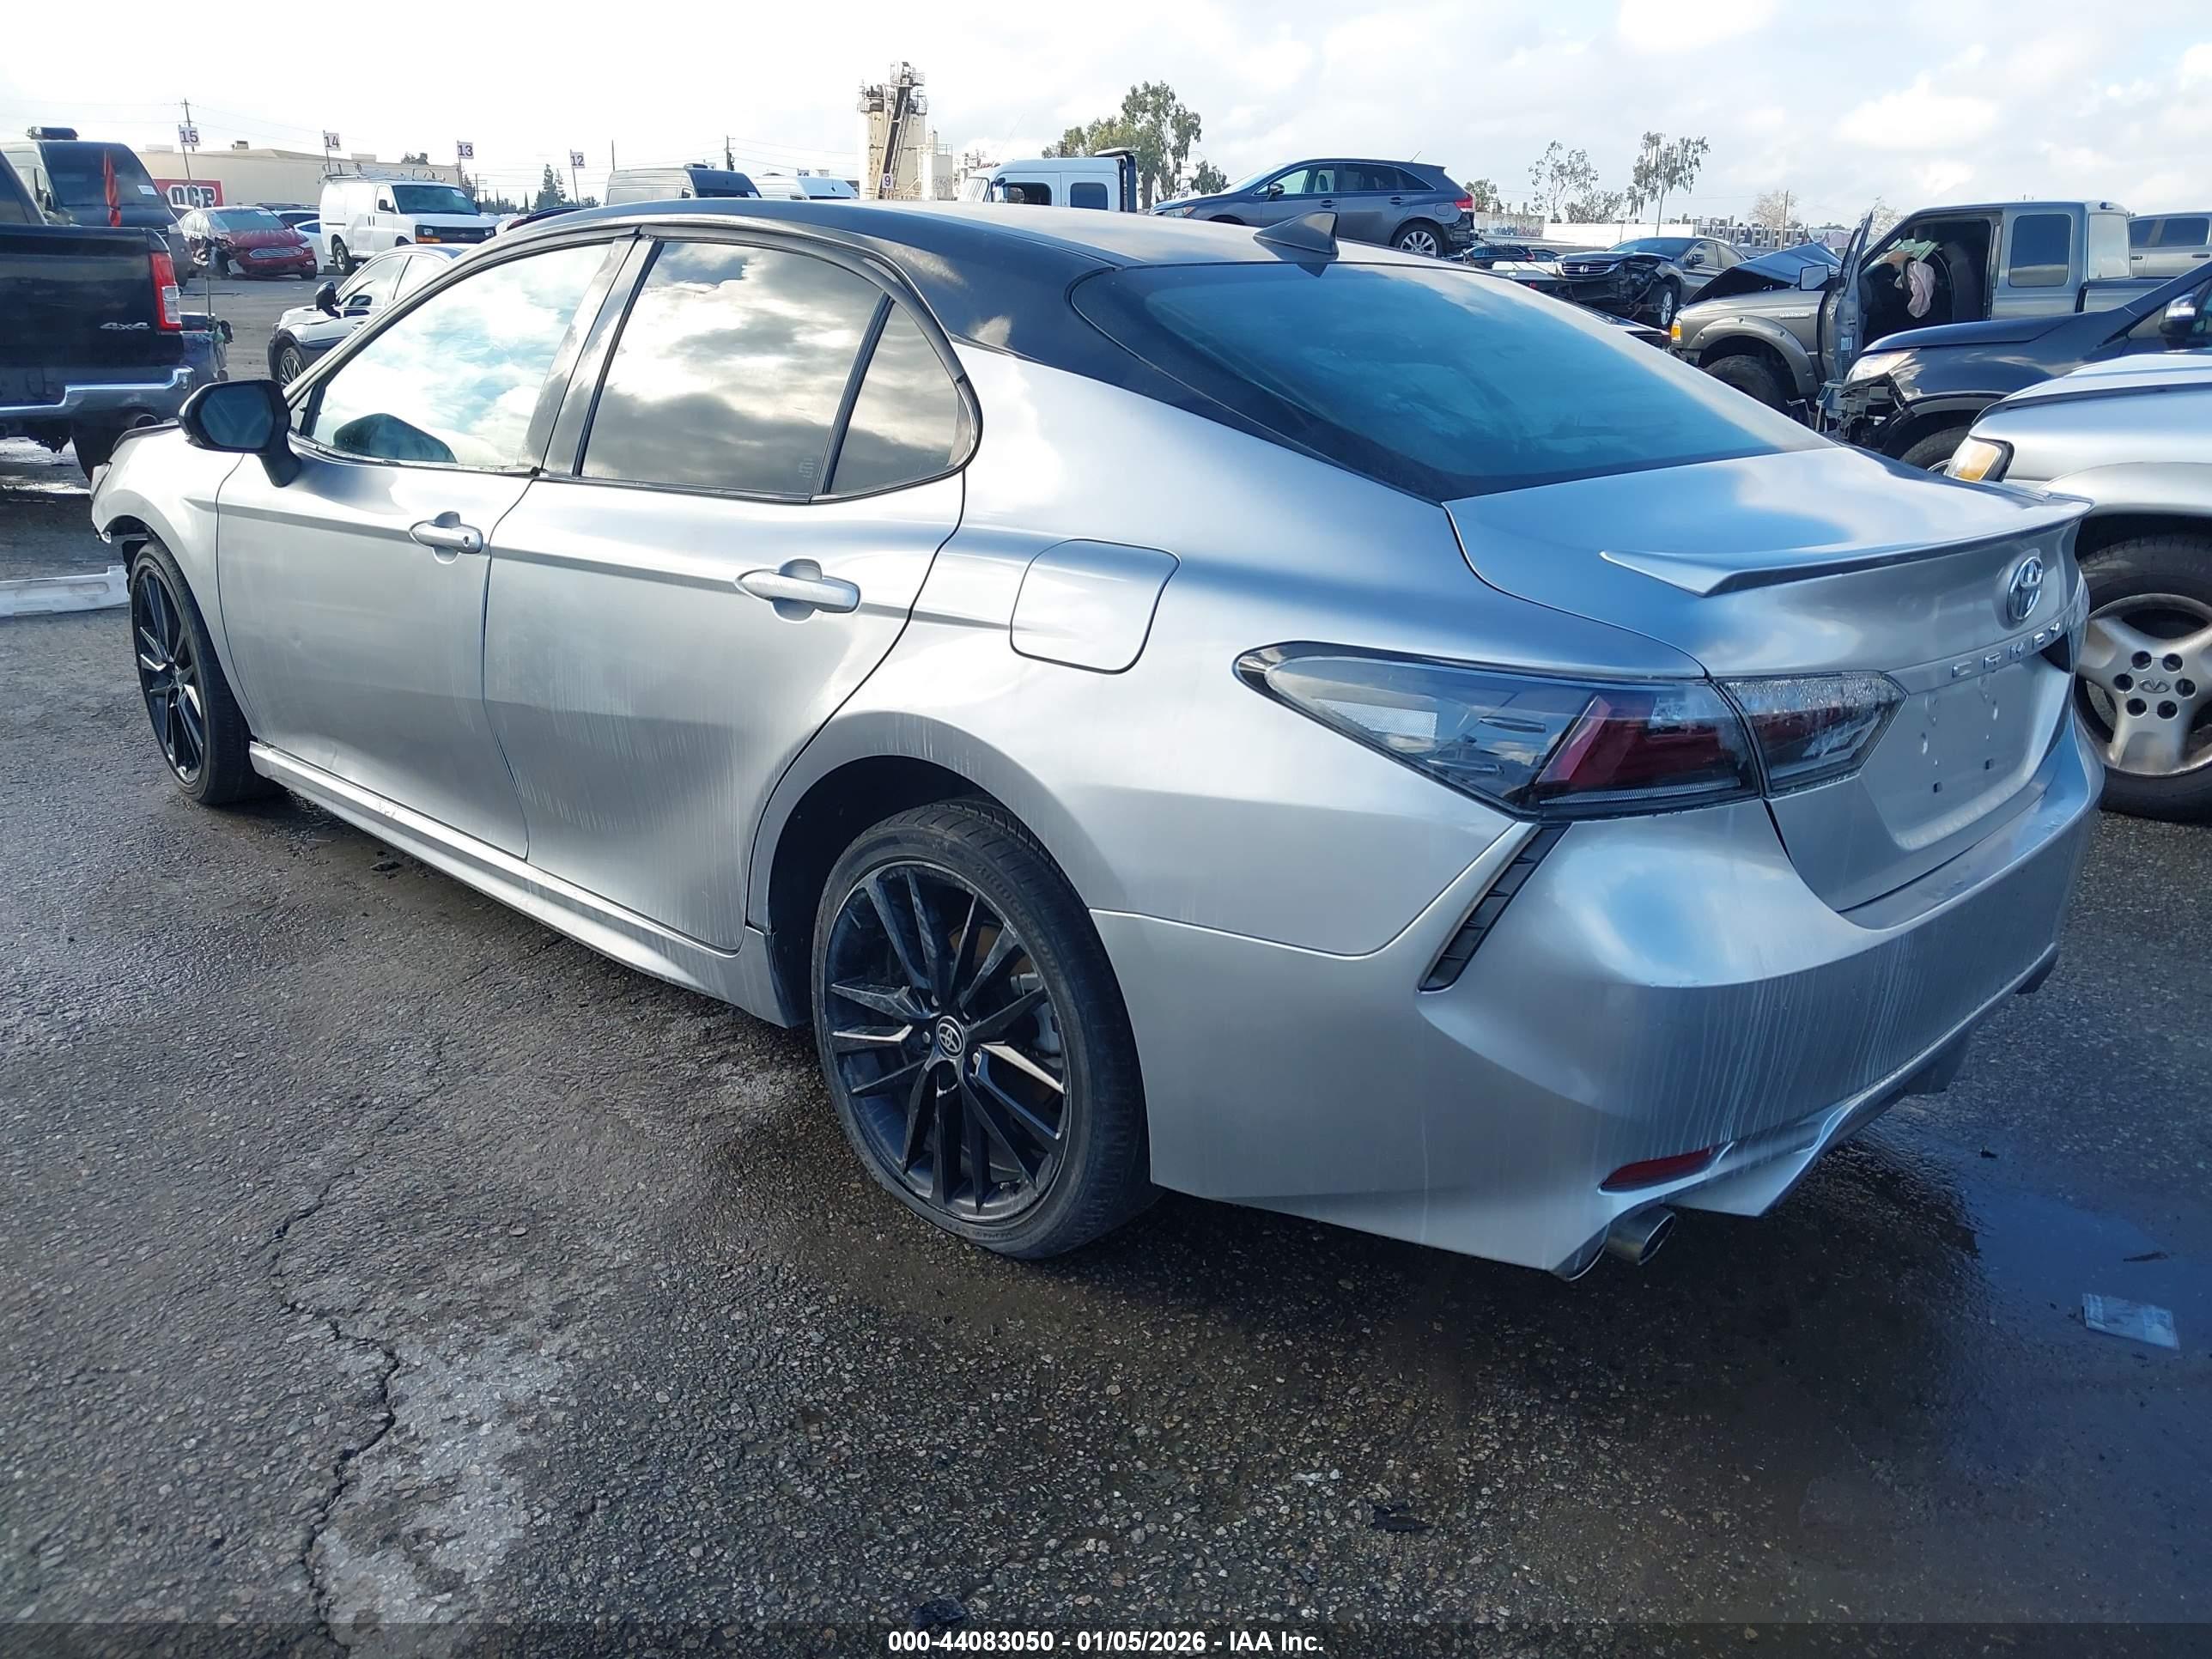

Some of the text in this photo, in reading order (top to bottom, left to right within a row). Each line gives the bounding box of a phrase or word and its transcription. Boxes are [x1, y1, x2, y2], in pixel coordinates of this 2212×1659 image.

[180, 130, 199, 143] 15
[324, 136, 341, 149] 14
[457, 144, 474, 157] 13
[571, 155, 585, 167] 12
[884, 175, 891, 186] 9
[1951, 622, 2061, 678] CAMRY
